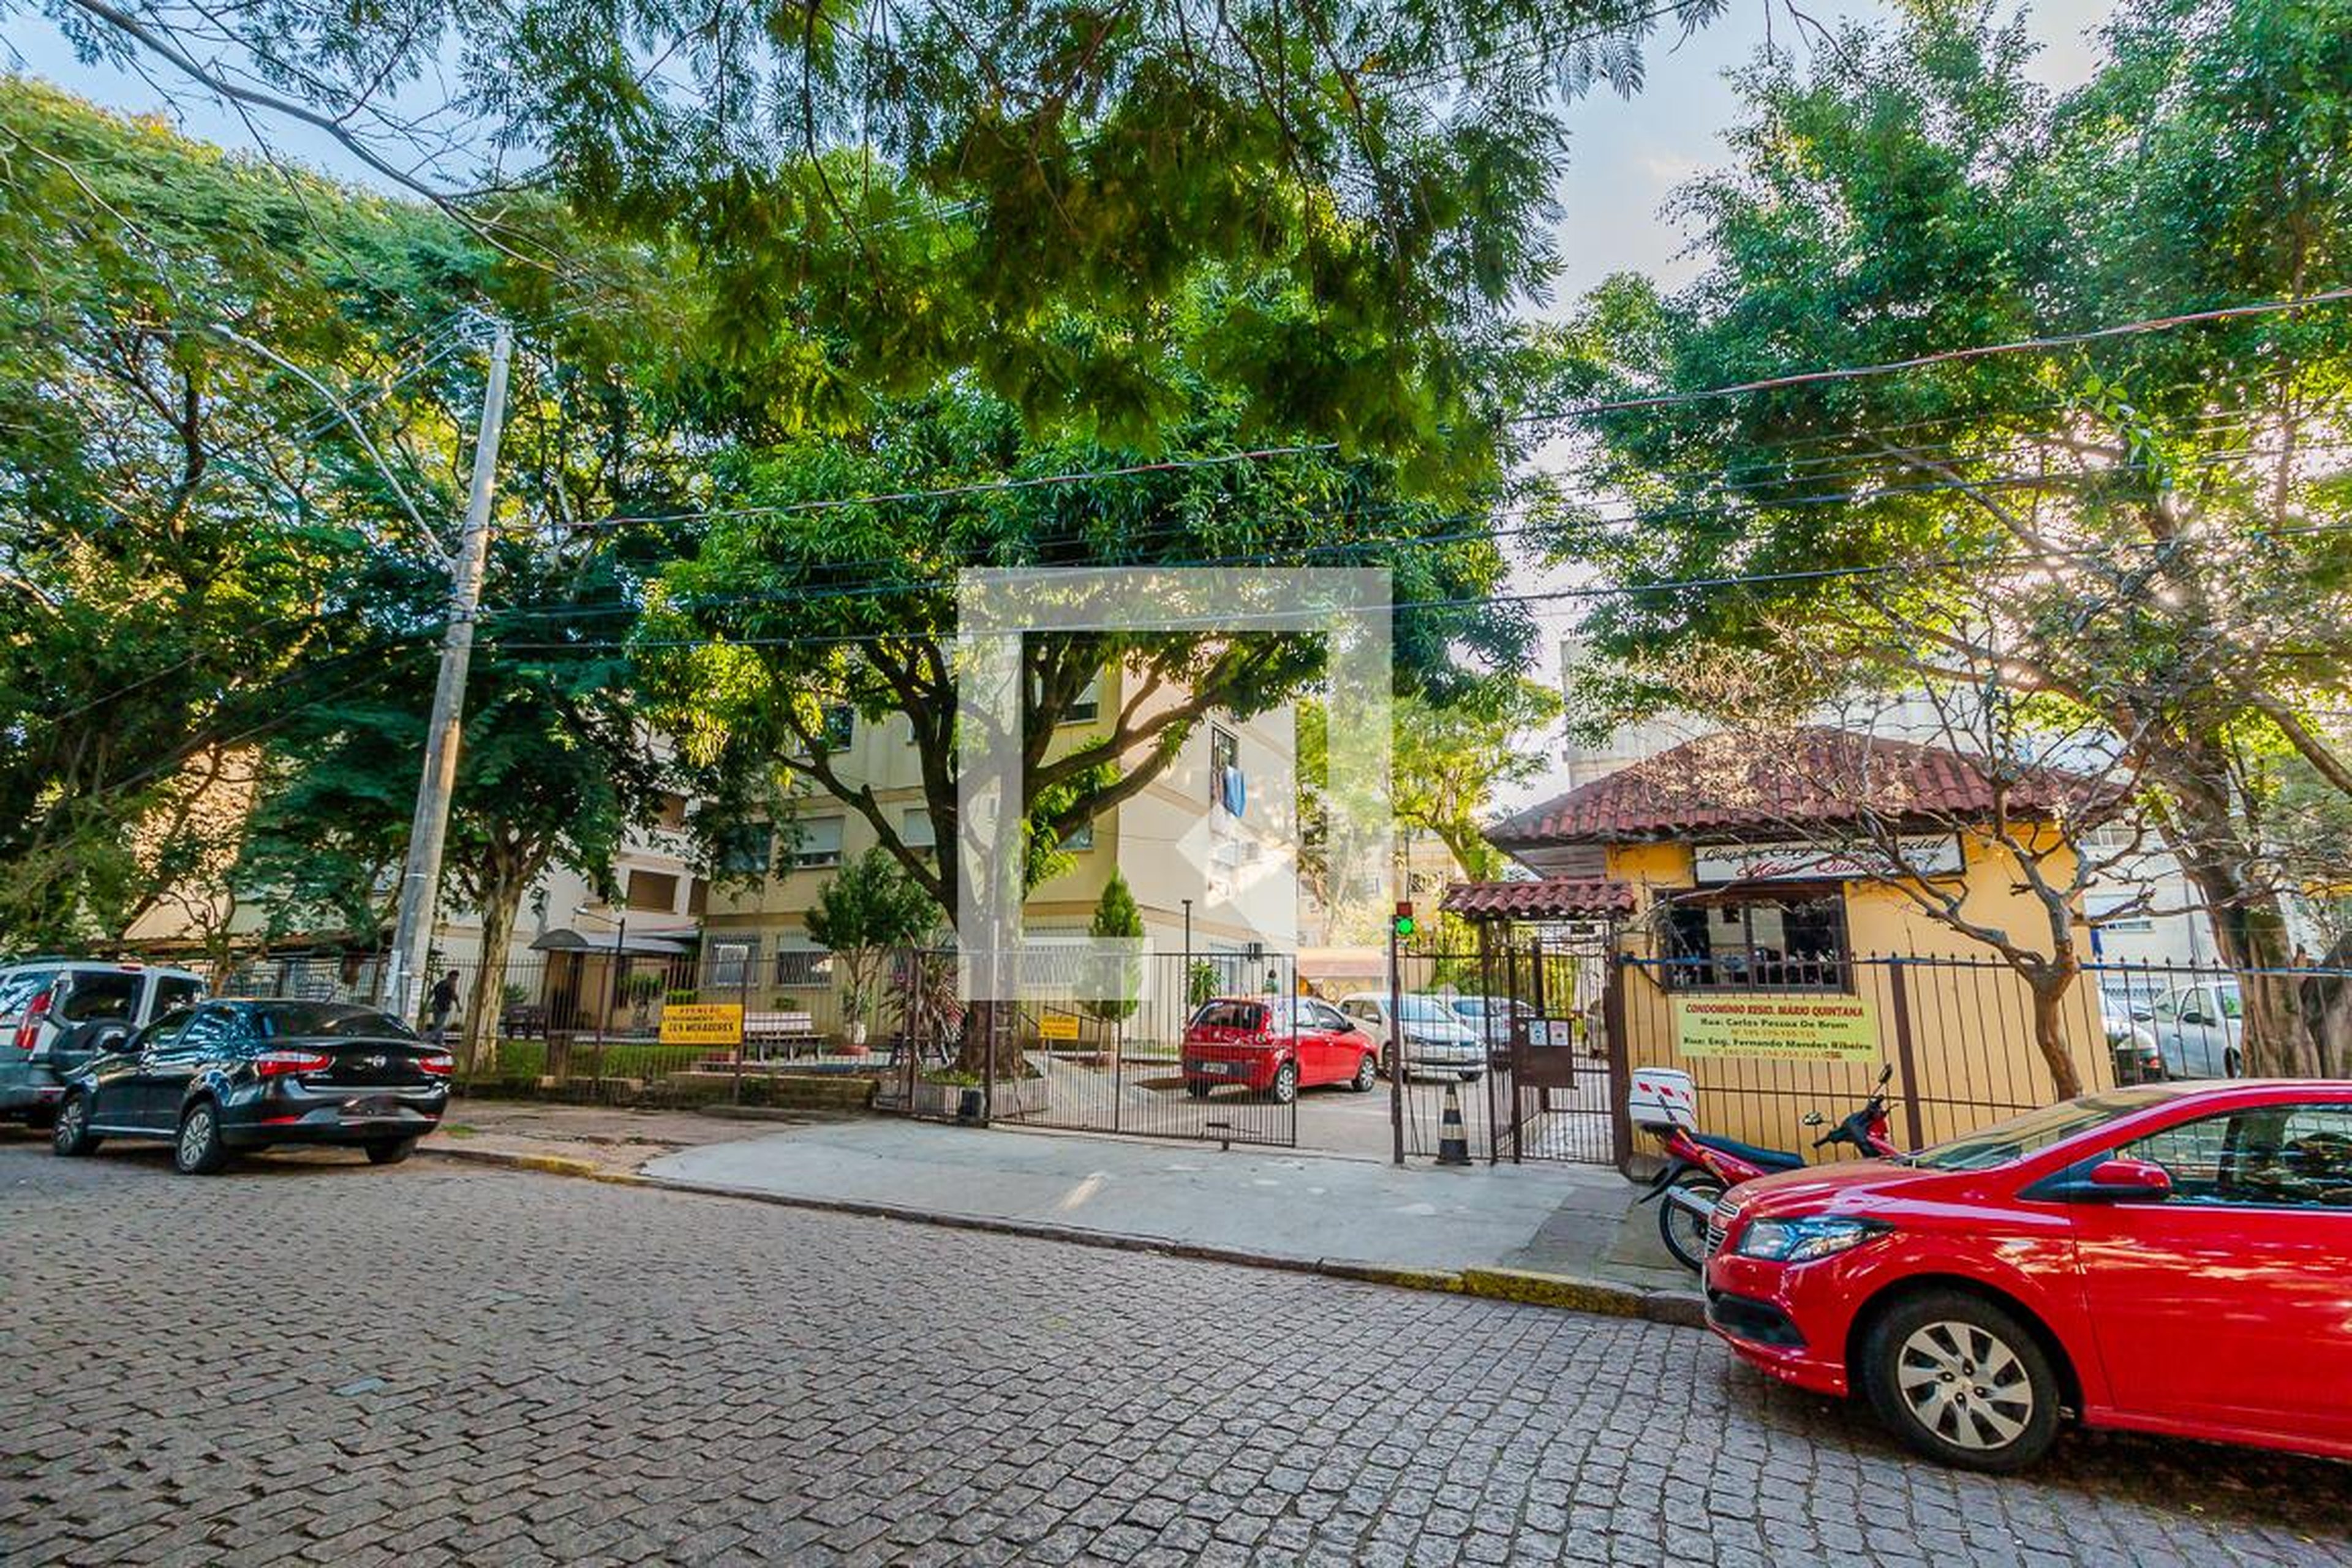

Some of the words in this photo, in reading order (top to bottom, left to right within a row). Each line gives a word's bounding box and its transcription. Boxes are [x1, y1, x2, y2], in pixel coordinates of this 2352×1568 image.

[1812, 1005, 1864, 1017] QUINTANA
[1726, 1018, 1758, 1027] Carlos
[1761, 1019, 1797, 1028] Pessoa
[1733, 1038, 1783, 1048] Fernando
[1785, 1040, 1828, 1049] Mendes
